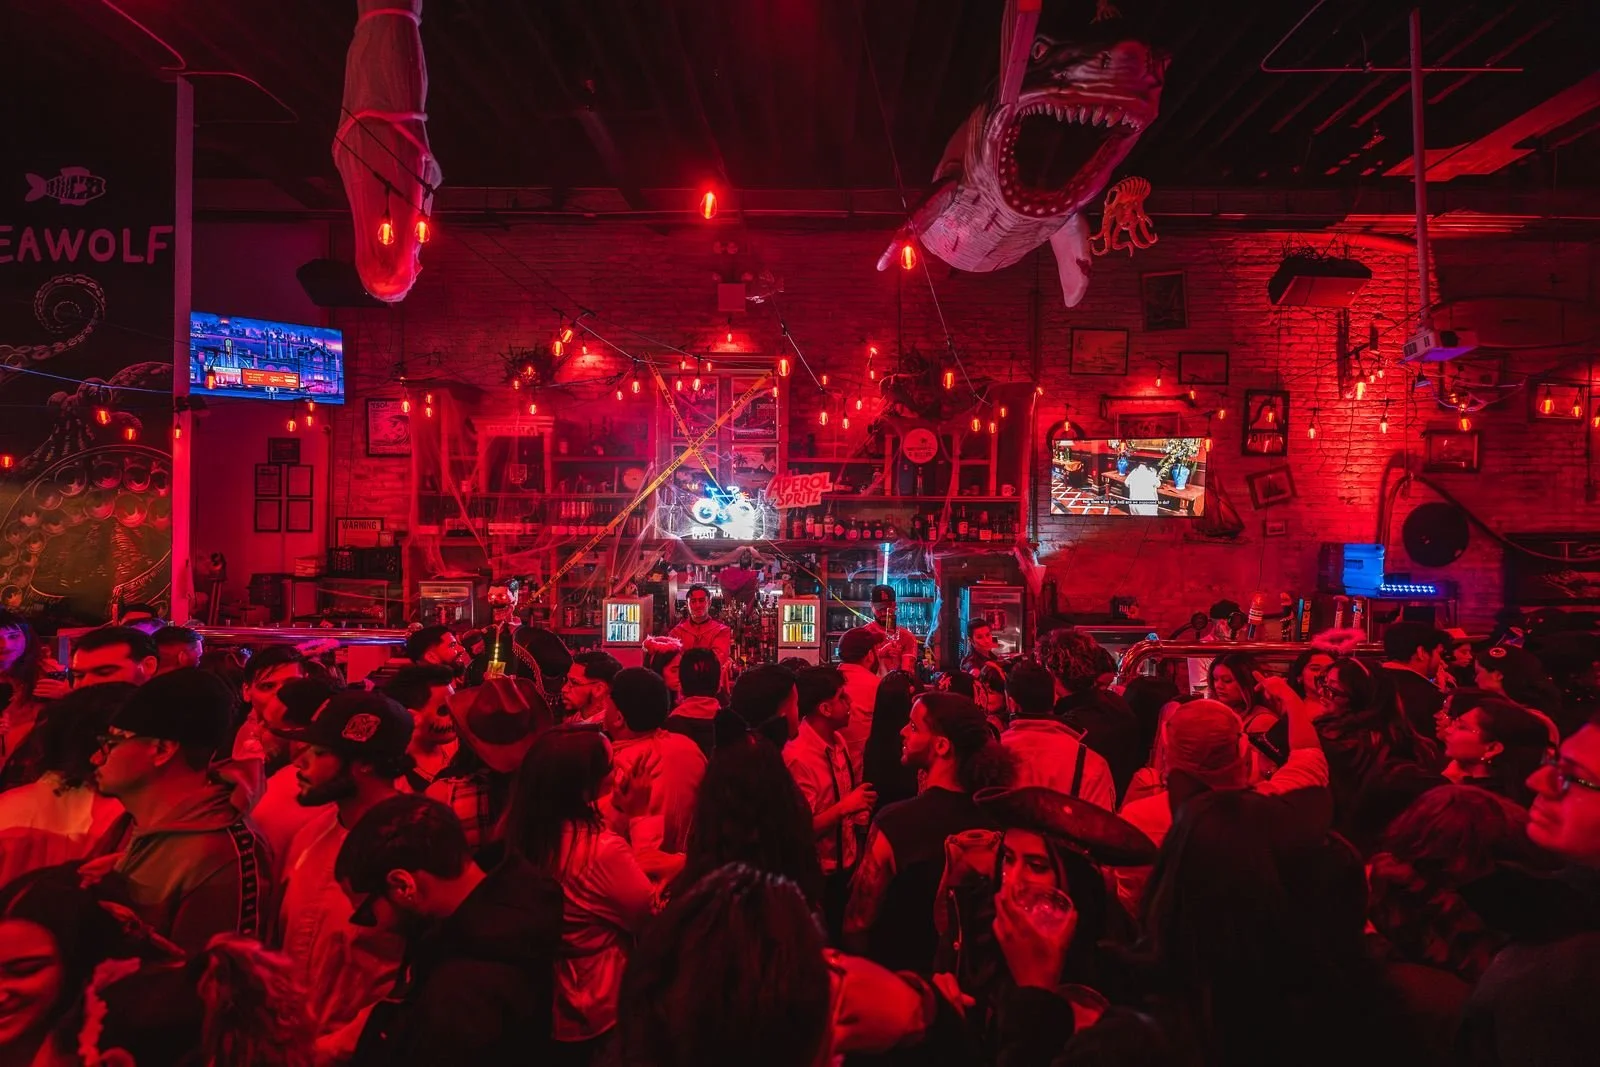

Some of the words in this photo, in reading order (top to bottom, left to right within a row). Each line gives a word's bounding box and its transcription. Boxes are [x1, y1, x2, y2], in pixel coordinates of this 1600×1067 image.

[0, 226, 173, 265] EAWOLF
[668, 457, 682, 472] ENTER
[767, 474, 830, 498] APEROL
[777, 490, 820, 506] SPRITZ
[342, 520, 377, 530] WARNING
